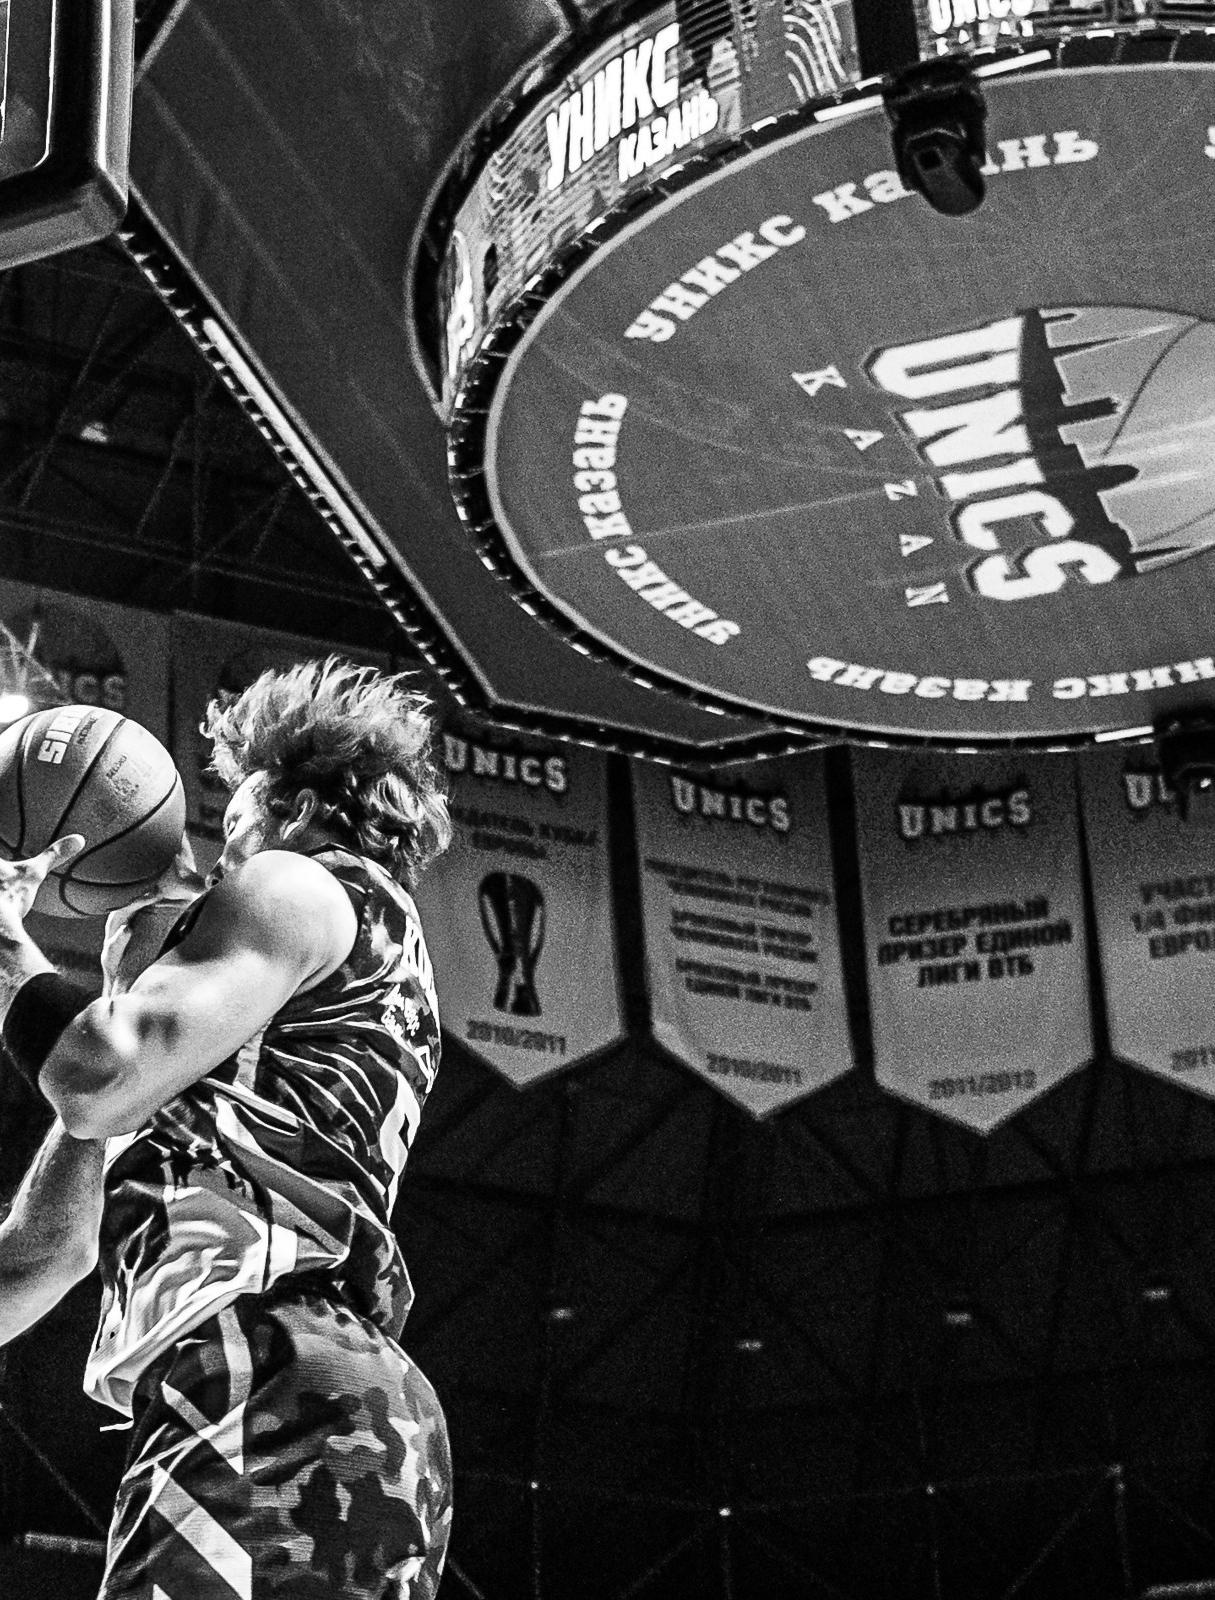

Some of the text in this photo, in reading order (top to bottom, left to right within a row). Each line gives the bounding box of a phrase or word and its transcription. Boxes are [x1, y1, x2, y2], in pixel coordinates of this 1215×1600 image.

[546, 23, 679, 190] УНИКС
[618, 89, 718, 183] КАЗАНЬ
[865, 315, 1121, 602] UNICS
[443, 734, 566, 793] UNICS
[672, 776, 790, 832] UNICS
[899, 790, 1031, 837] UNICS
[877, 919, 1073, 967] ПРИЗЕР ЕДИНОЙ
[888, 895, 1050, 938] СЕРЕБРЯНЫЙ
[917, 954, 1034, 988] ЛИГИ ВТБ
